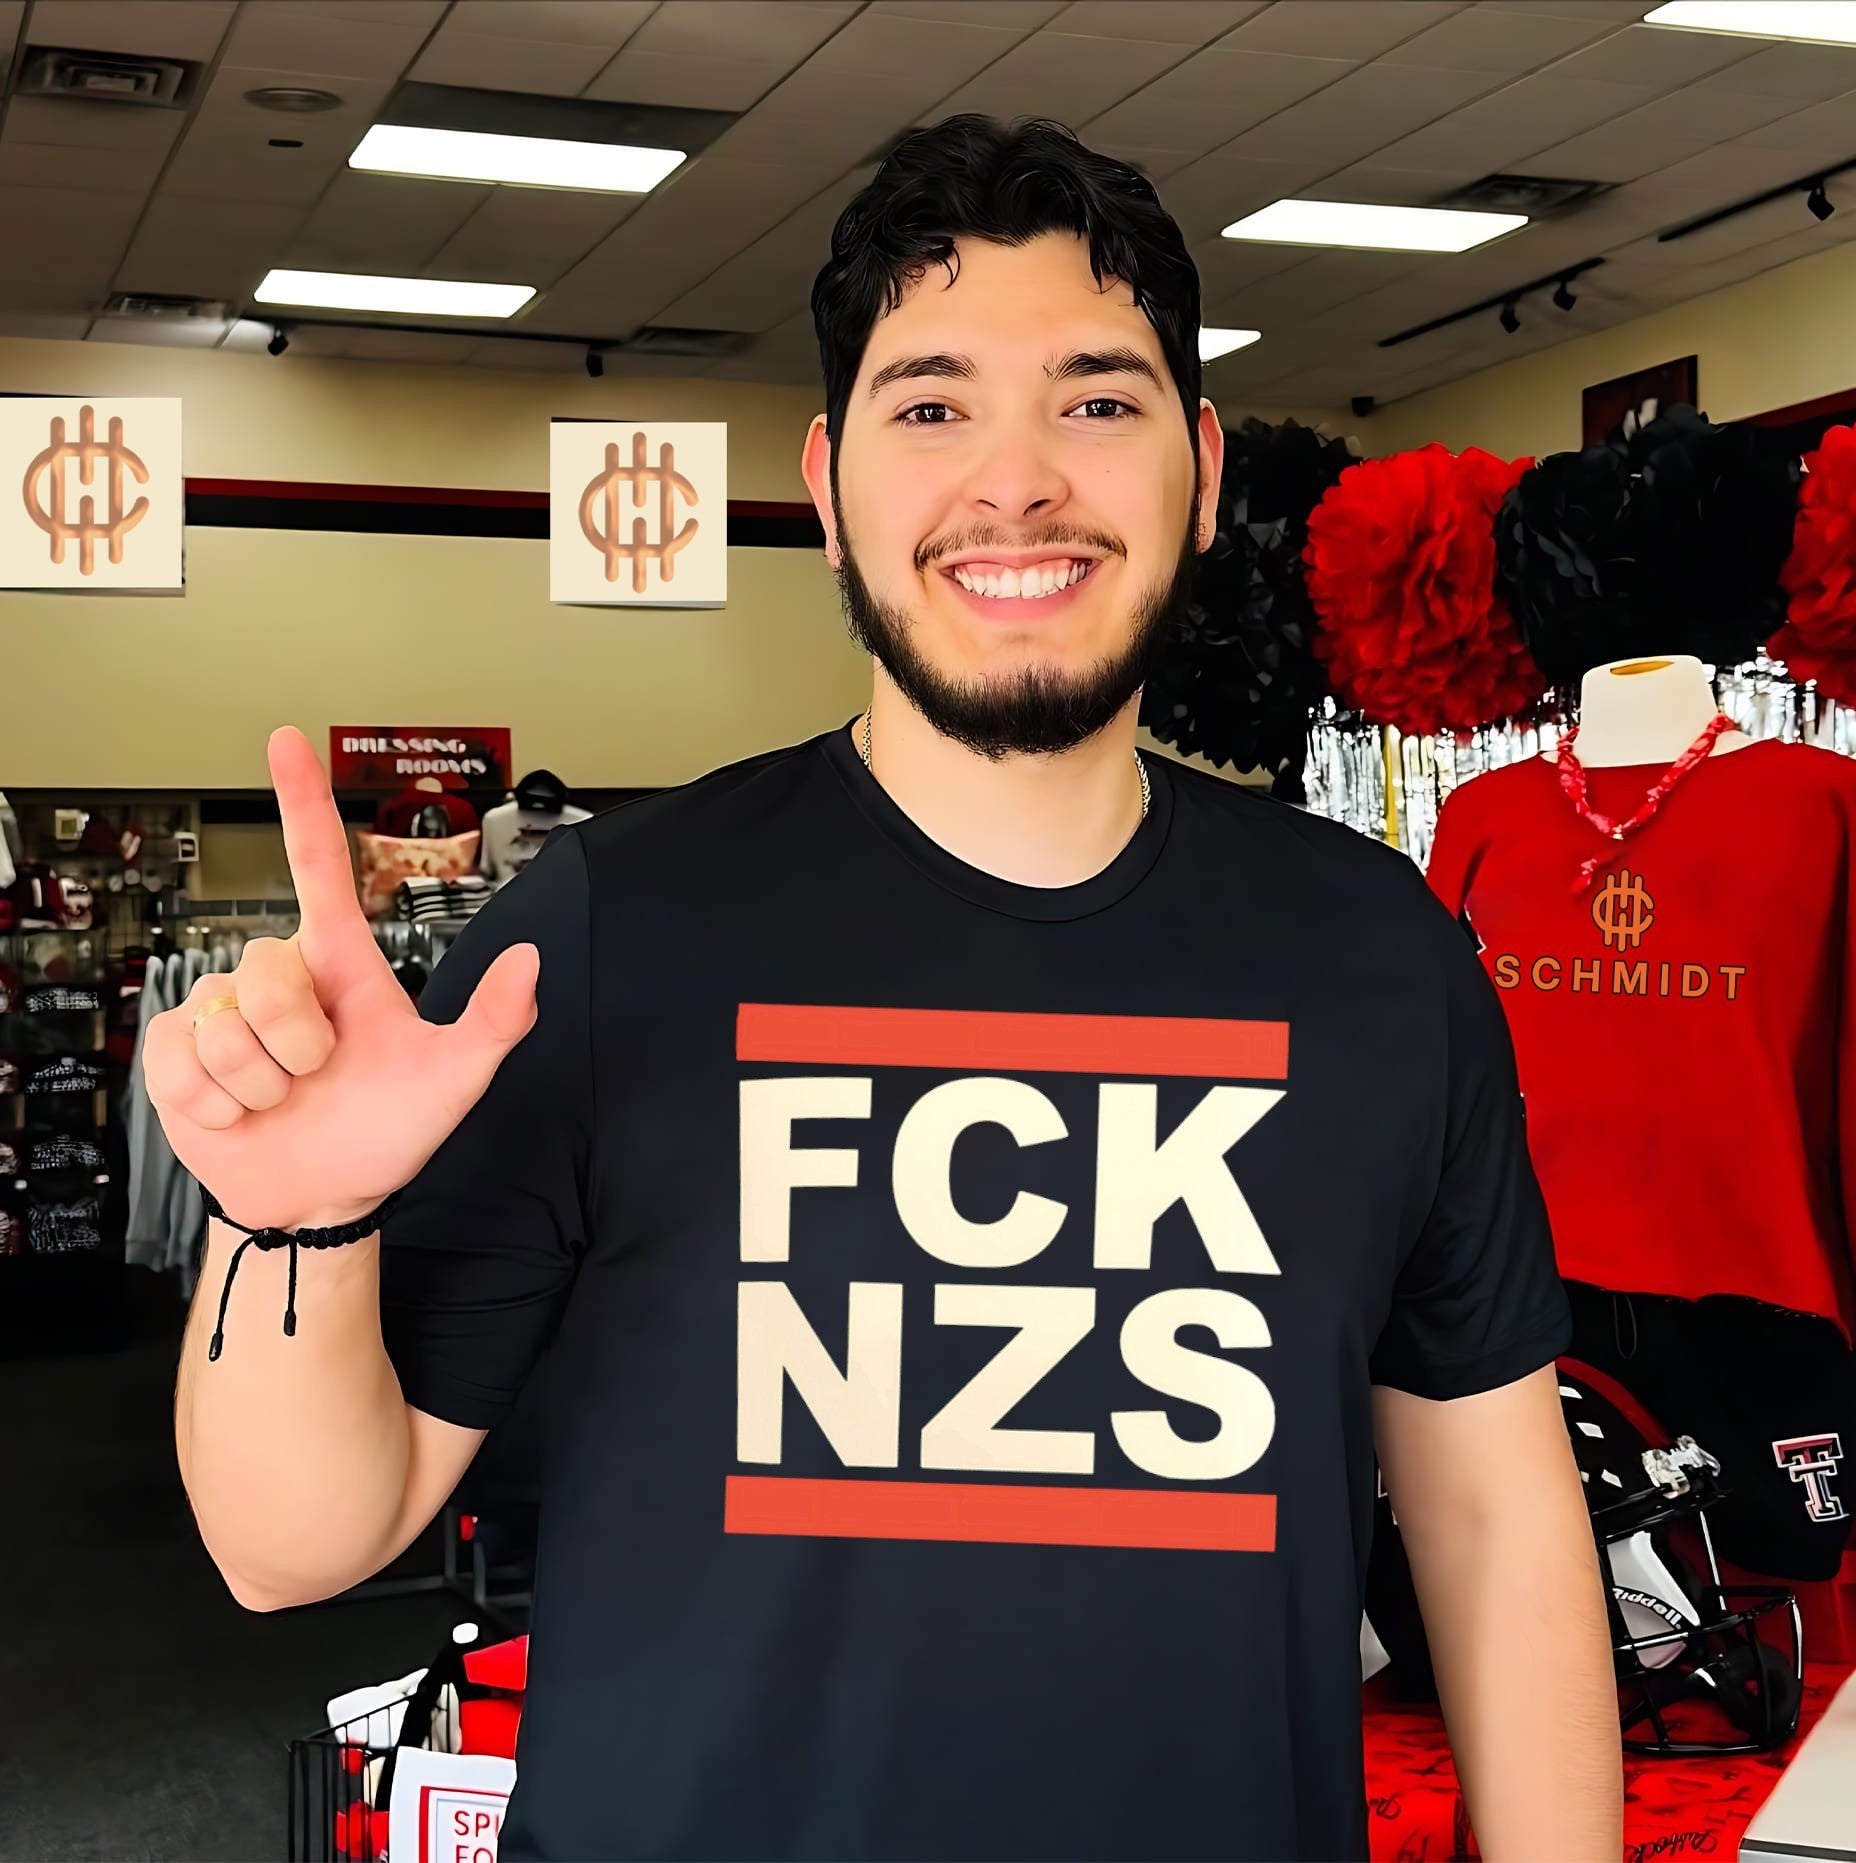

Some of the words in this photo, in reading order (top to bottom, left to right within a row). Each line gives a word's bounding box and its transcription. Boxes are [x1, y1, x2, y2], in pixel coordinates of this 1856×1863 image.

[396, 758, 487, 776] ROOMS
[1494, 954, 1747, 1001] SCHMIDT
[739, 1076, 1288, 1276] FCK
[737, 1281, 1276, 1480] NZS
